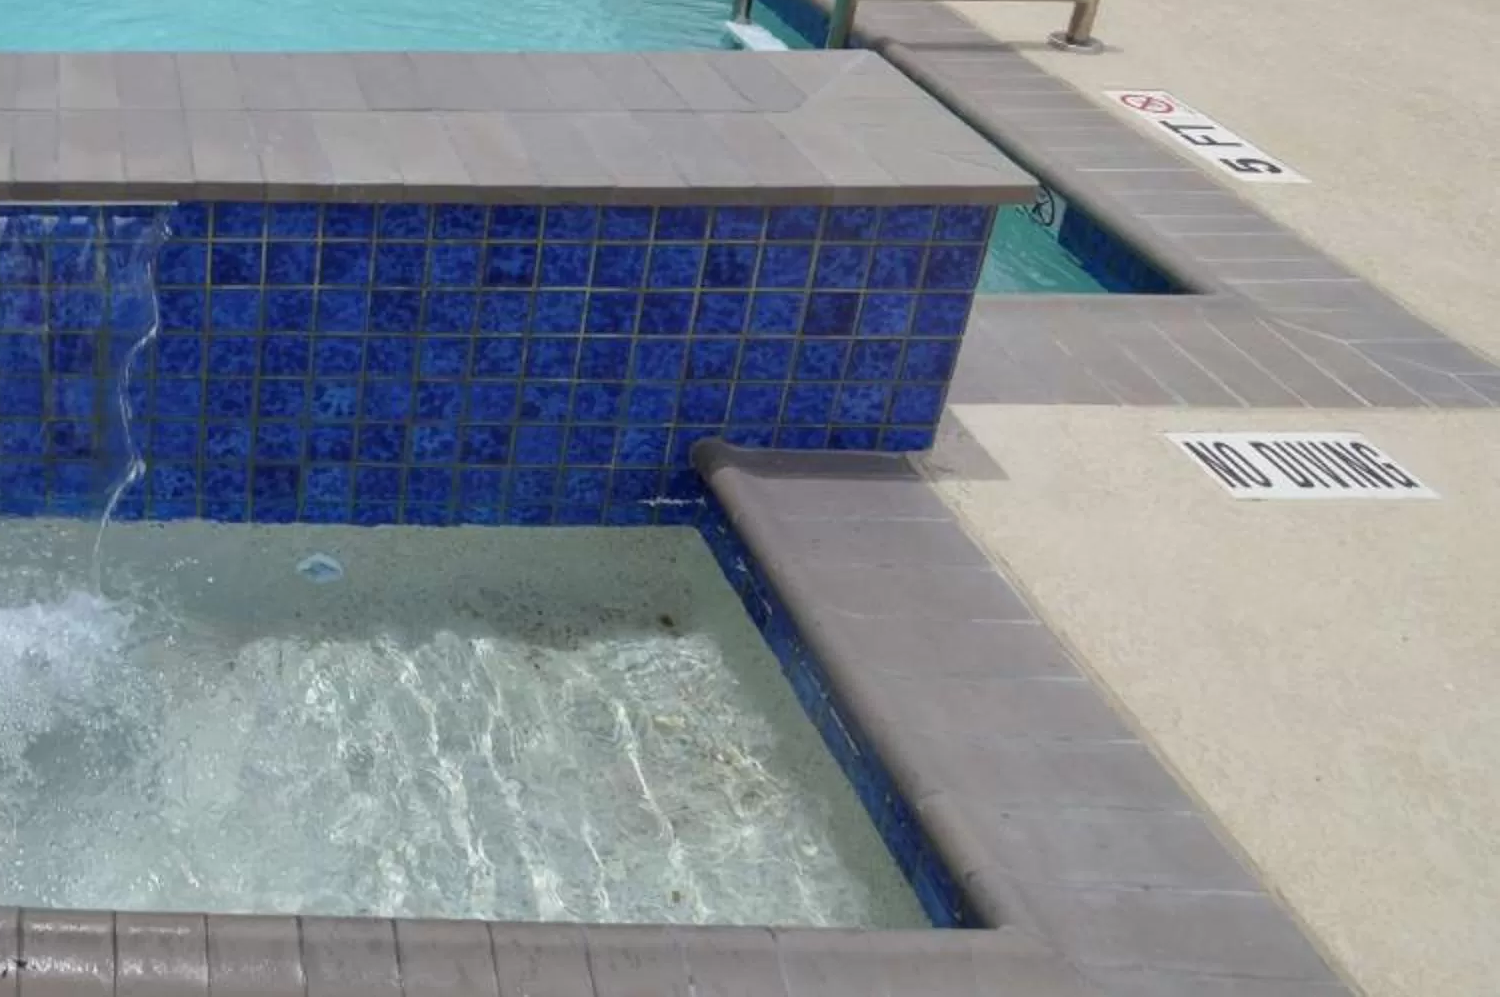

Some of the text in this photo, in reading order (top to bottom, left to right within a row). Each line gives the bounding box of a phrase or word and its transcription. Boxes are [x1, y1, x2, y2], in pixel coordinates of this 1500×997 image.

[1159, 120, 1283, 175] 5 FT
[1182, 440, 1420, 489] NO DIVING
